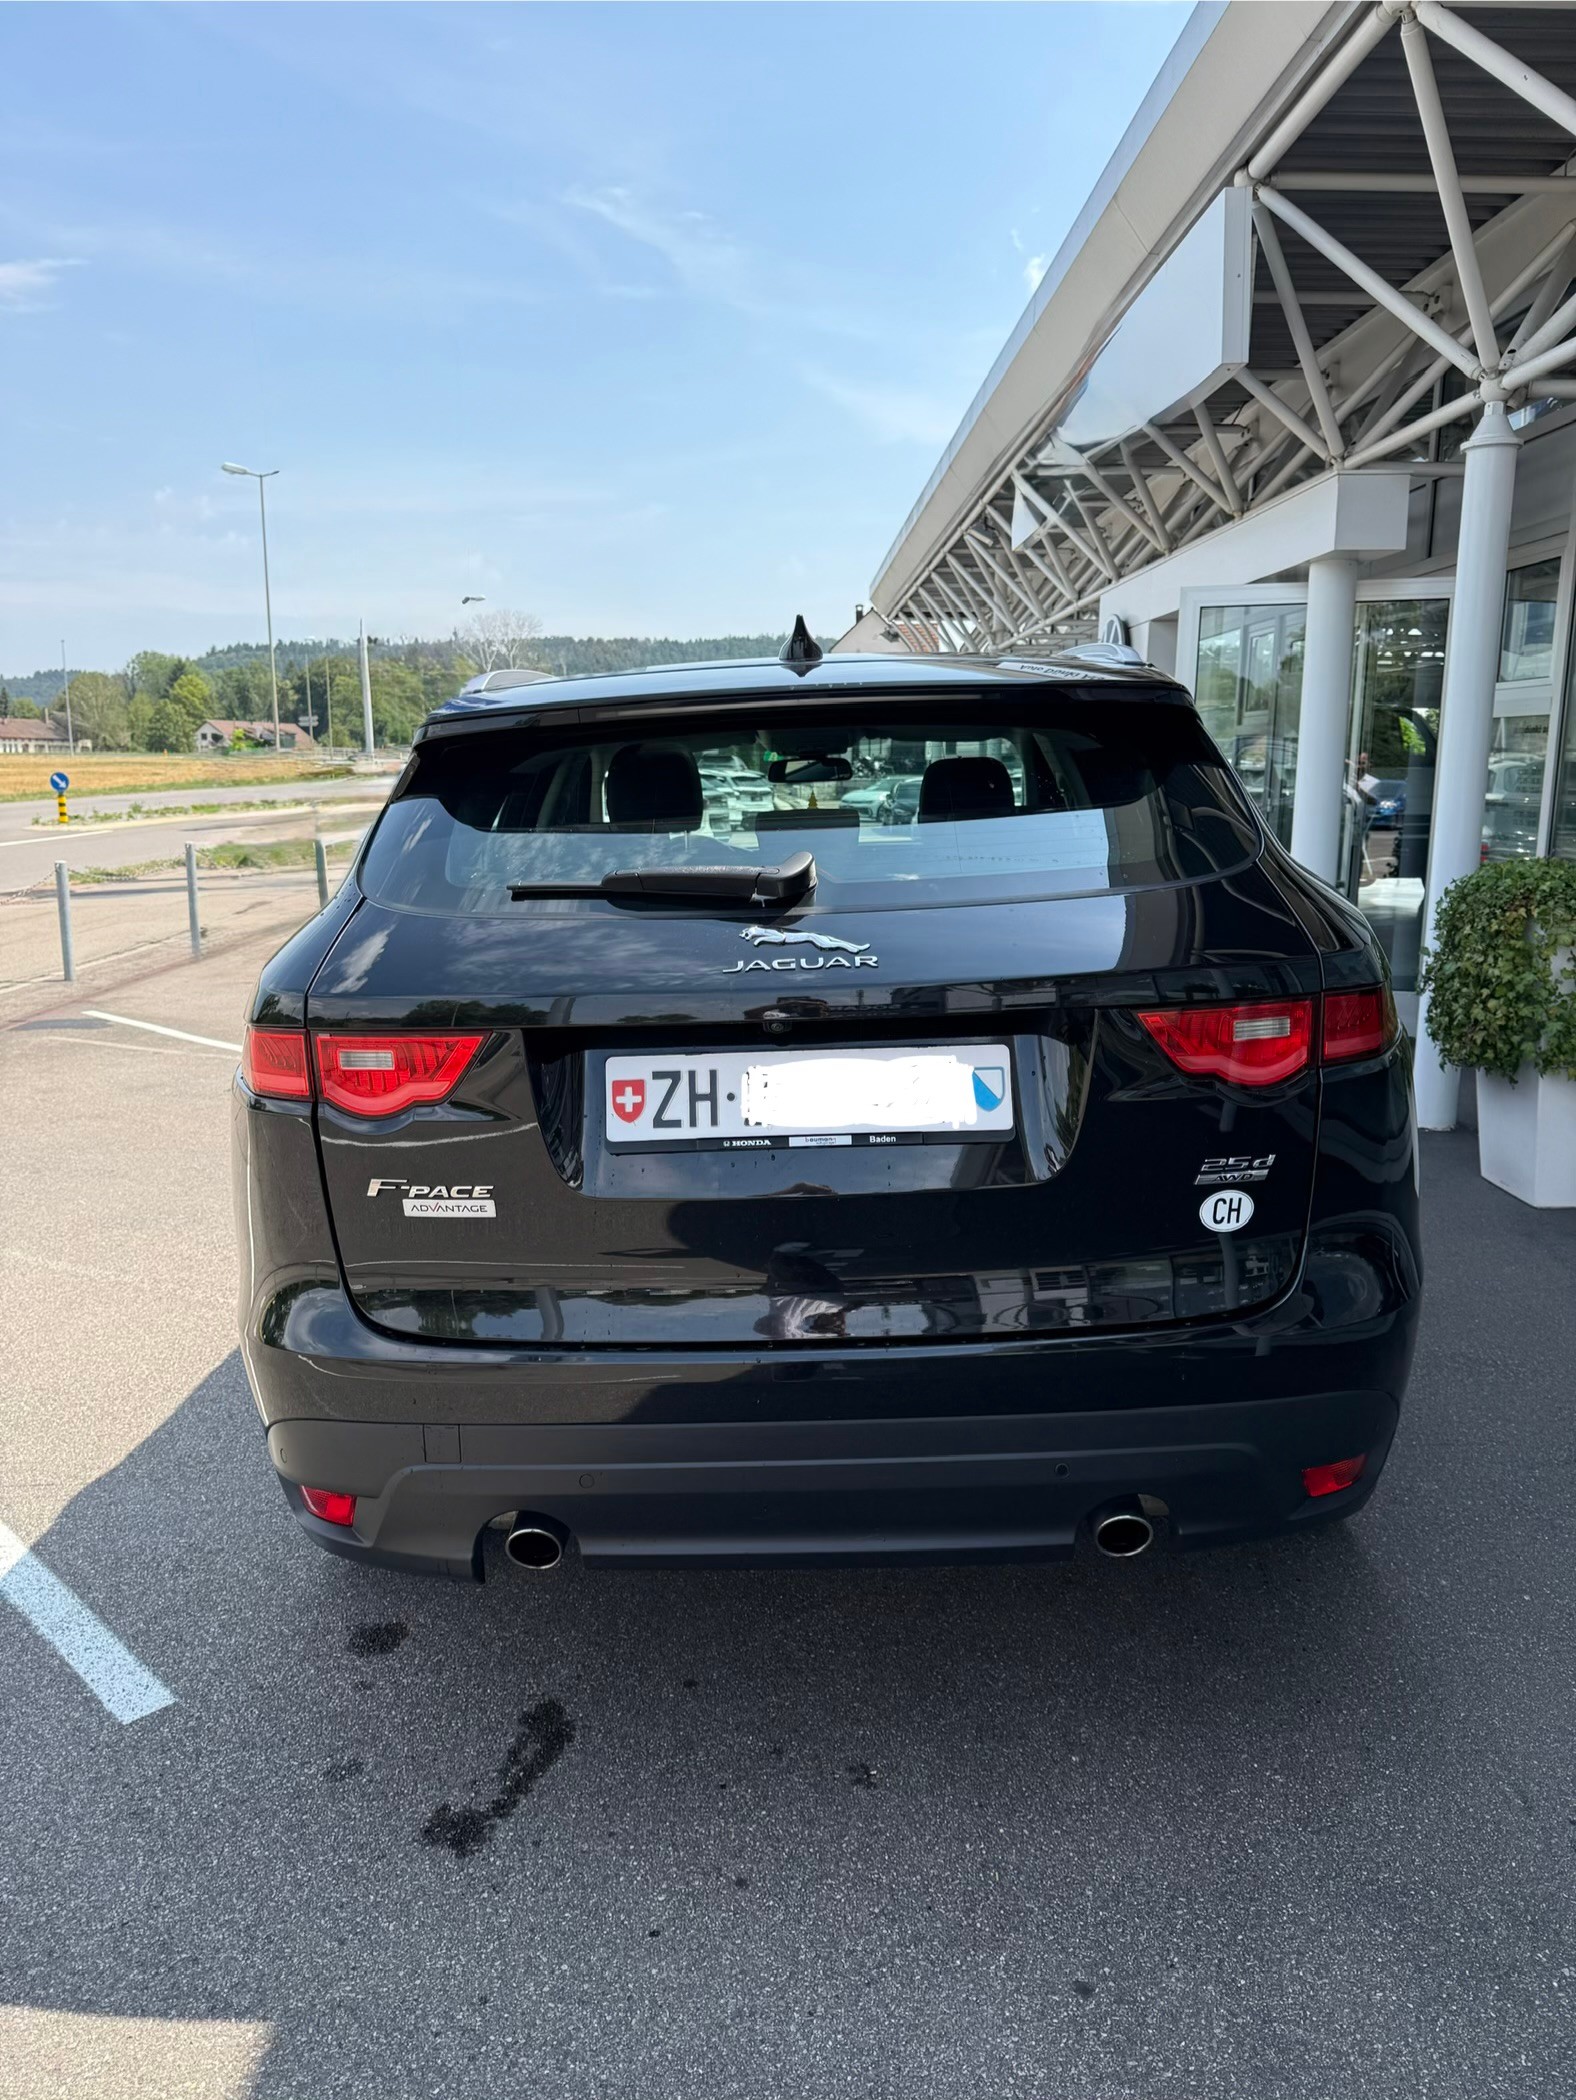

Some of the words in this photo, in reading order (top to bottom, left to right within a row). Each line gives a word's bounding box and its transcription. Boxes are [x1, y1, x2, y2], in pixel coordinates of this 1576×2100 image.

[722, 955, 879, 973] JAGUAR
[731, 1139, 772, 1147] HONDA
[869, 1135, 897, 1144] Baden
[1200, 1154, 1276, 1172] 25d
[1214, 1173, 1253, 1182] AWD
[367, 1178, 494, 1198] F-PACE
[410, 1202, 489, 1213] ADVANTAGE
[1212, 1197, 1243, 1225] CH
